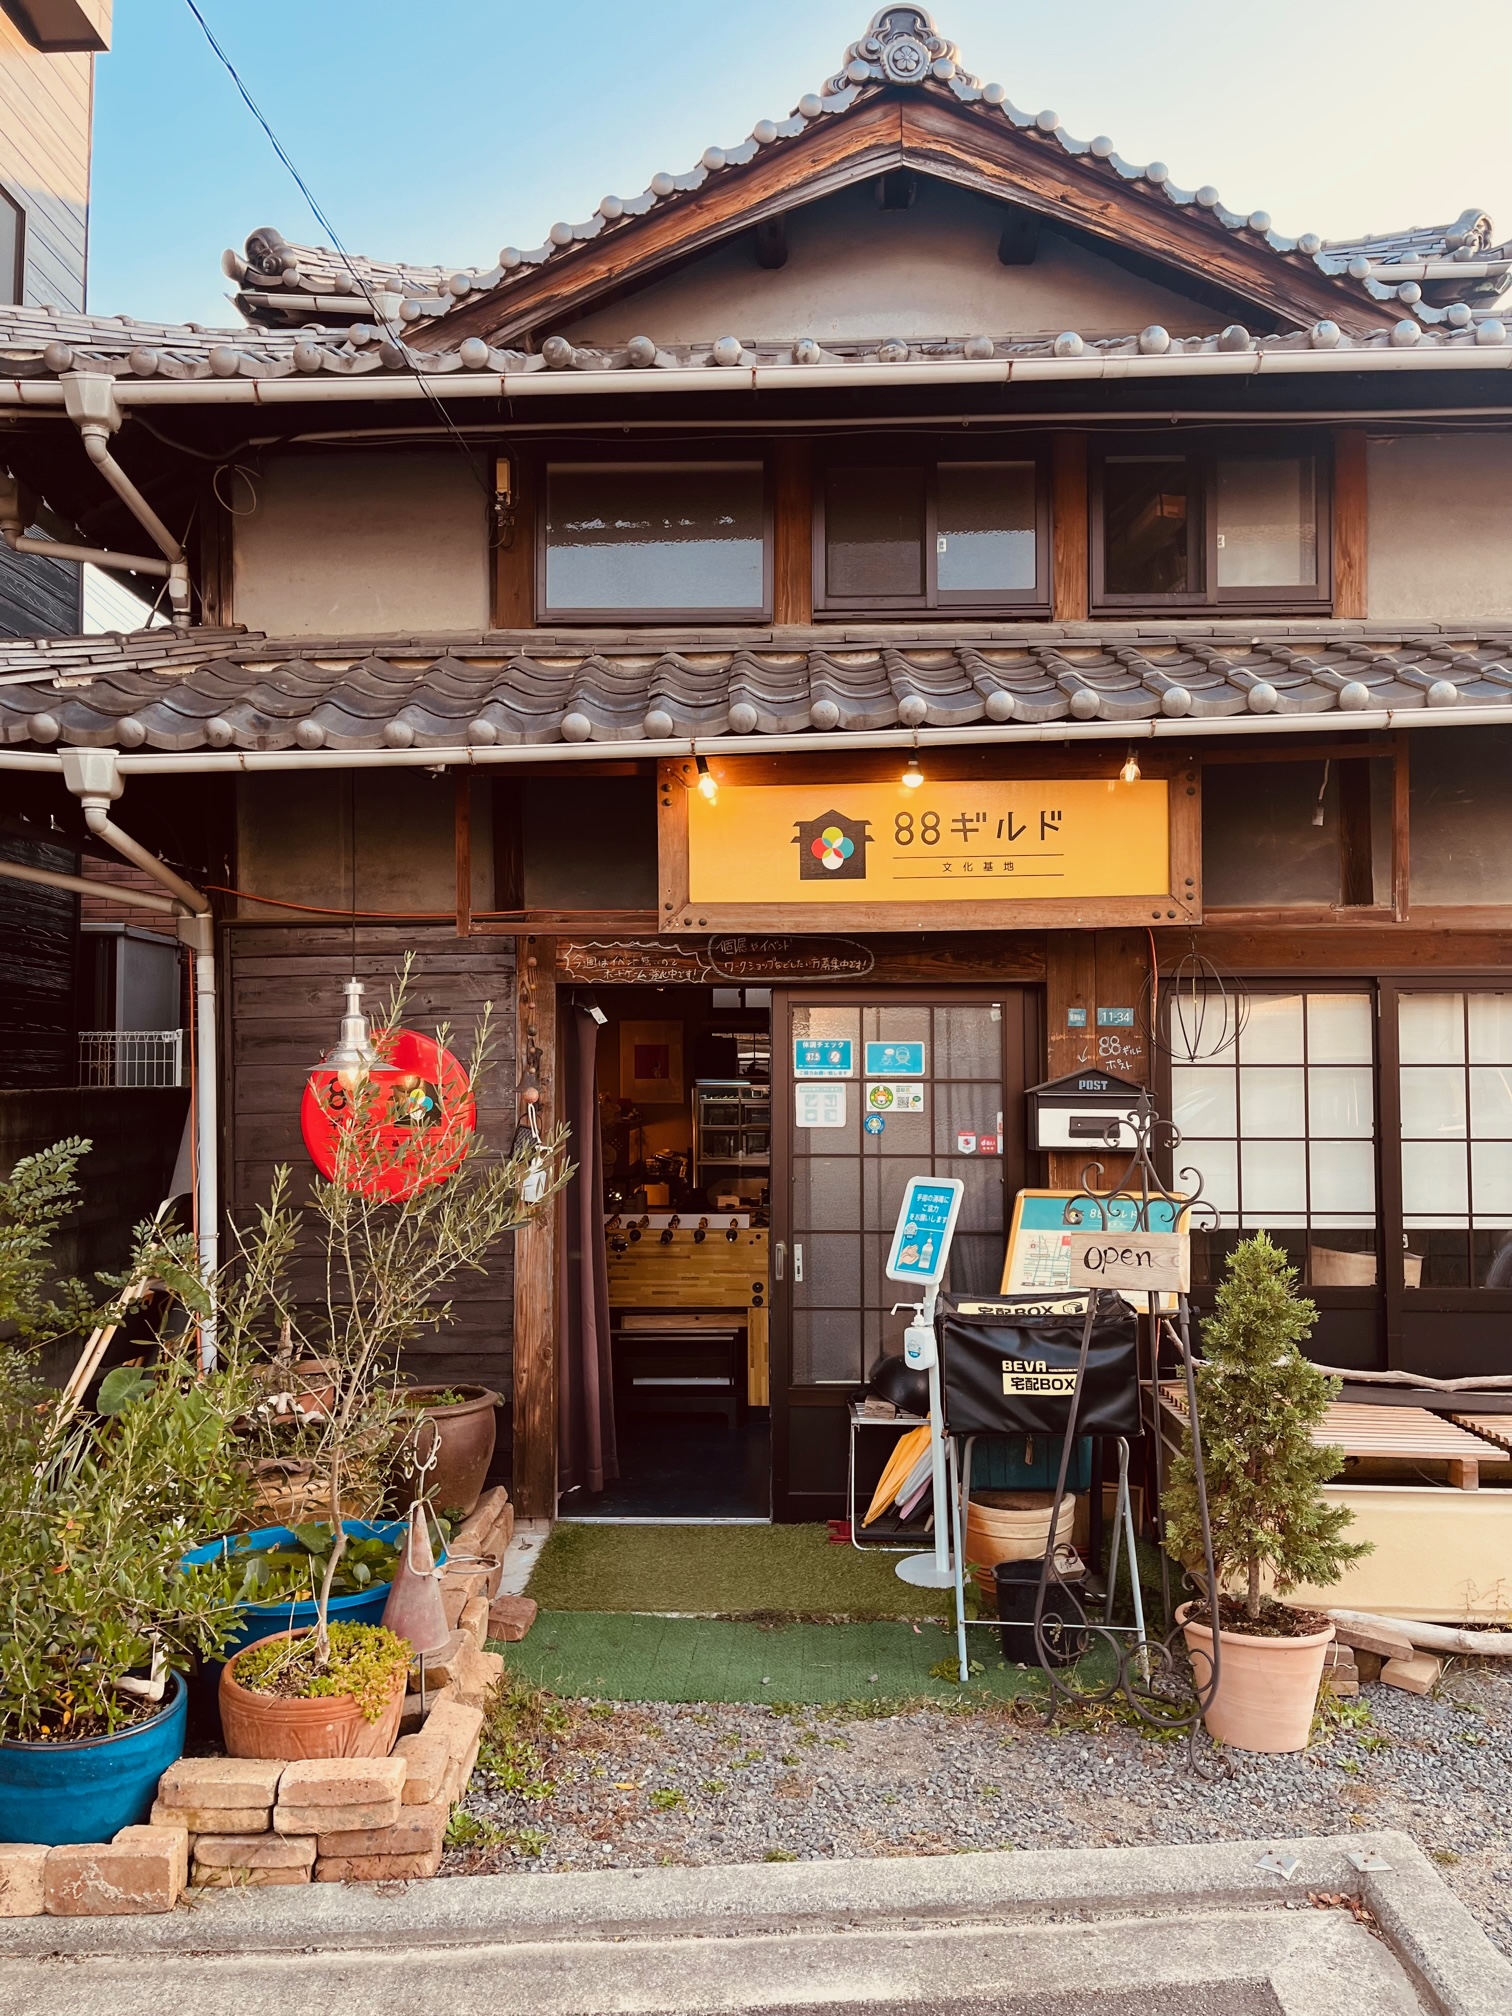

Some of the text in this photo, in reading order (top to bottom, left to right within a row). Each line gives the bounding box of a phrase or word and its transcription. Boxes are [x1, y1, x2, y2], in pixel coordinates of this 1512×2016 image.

[894, 810, 1063, 846] 88ギルド
[942, 861, 1015, 873] 文化基地
[1102, 1011, 1130, 1023] 11-34
[1099, 1035, 1142, 1057] 88ギルド
[1106, 1059, 1132, 1071] ポスト
[1079, 1081, 1108, 1090] POST
[1002, 1360, 1047, 1372] BEVA
[1011, 1377, 1075, 1391] 宅配BOX
